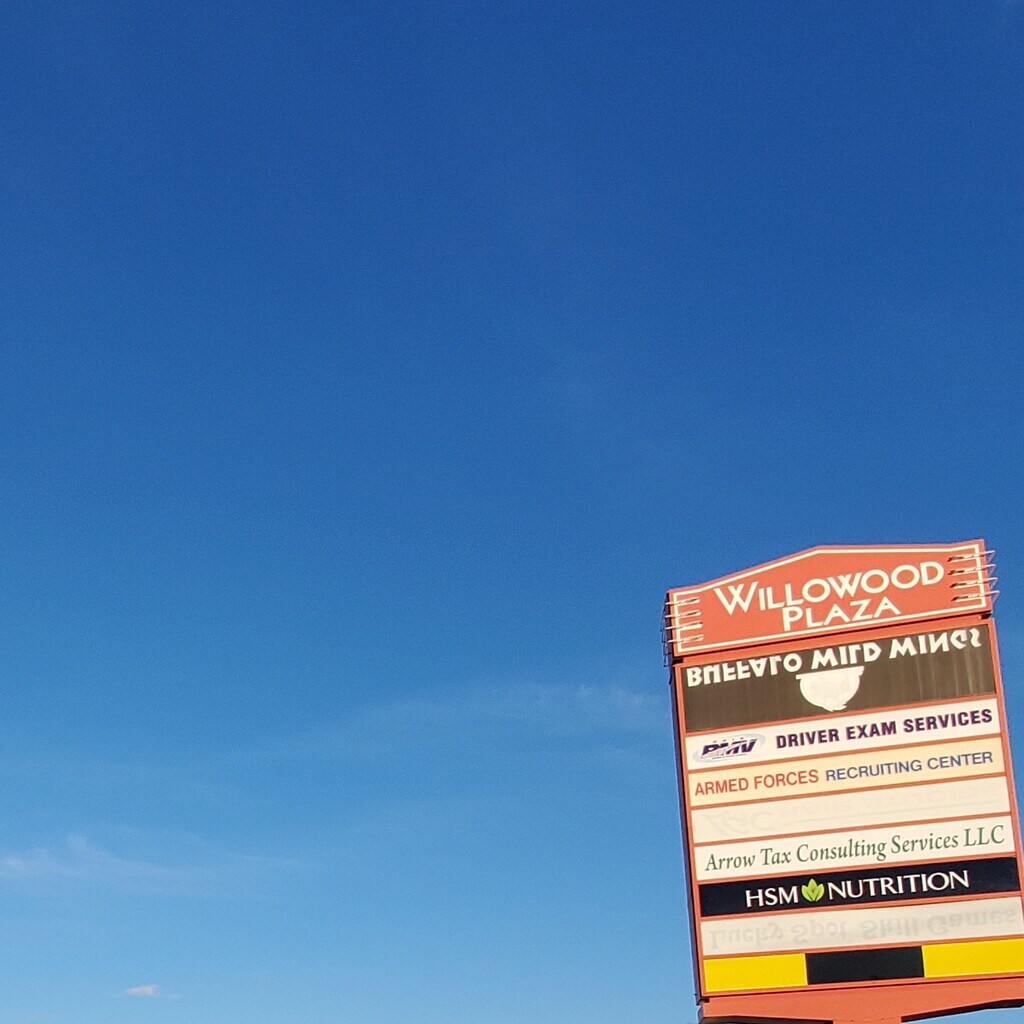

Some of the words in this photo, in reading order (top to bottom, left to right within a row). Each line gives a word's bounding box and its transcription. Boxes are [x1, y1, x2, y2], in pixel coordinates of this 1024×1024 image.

[713, 561, 945, 616] WILLOWOOD
[782, 595, 902, 633] PLAZA
[775, 728, 840, 750] DRIVER
[845, 720, 898, 742] EXAM
[902, 708, 993, 734] SERVICES
[694, 774, 750, 797] ARMED
[753, 769, 820, 790] FORCES
[825, 758, 924, 783] RECRUITING
[926, 750, 994, 771] CENTER
[703, 852, 757, 873] Arrow
[759, 847, 792, 867] Tax
[795, 837, 888, 863] Consulting
[890, 830, 960, 855] Services
[962, 824, 1006, 848] LLC
[744, 885, 799, 908] HSM
[826, 869, 971, 901] NUTRITION
